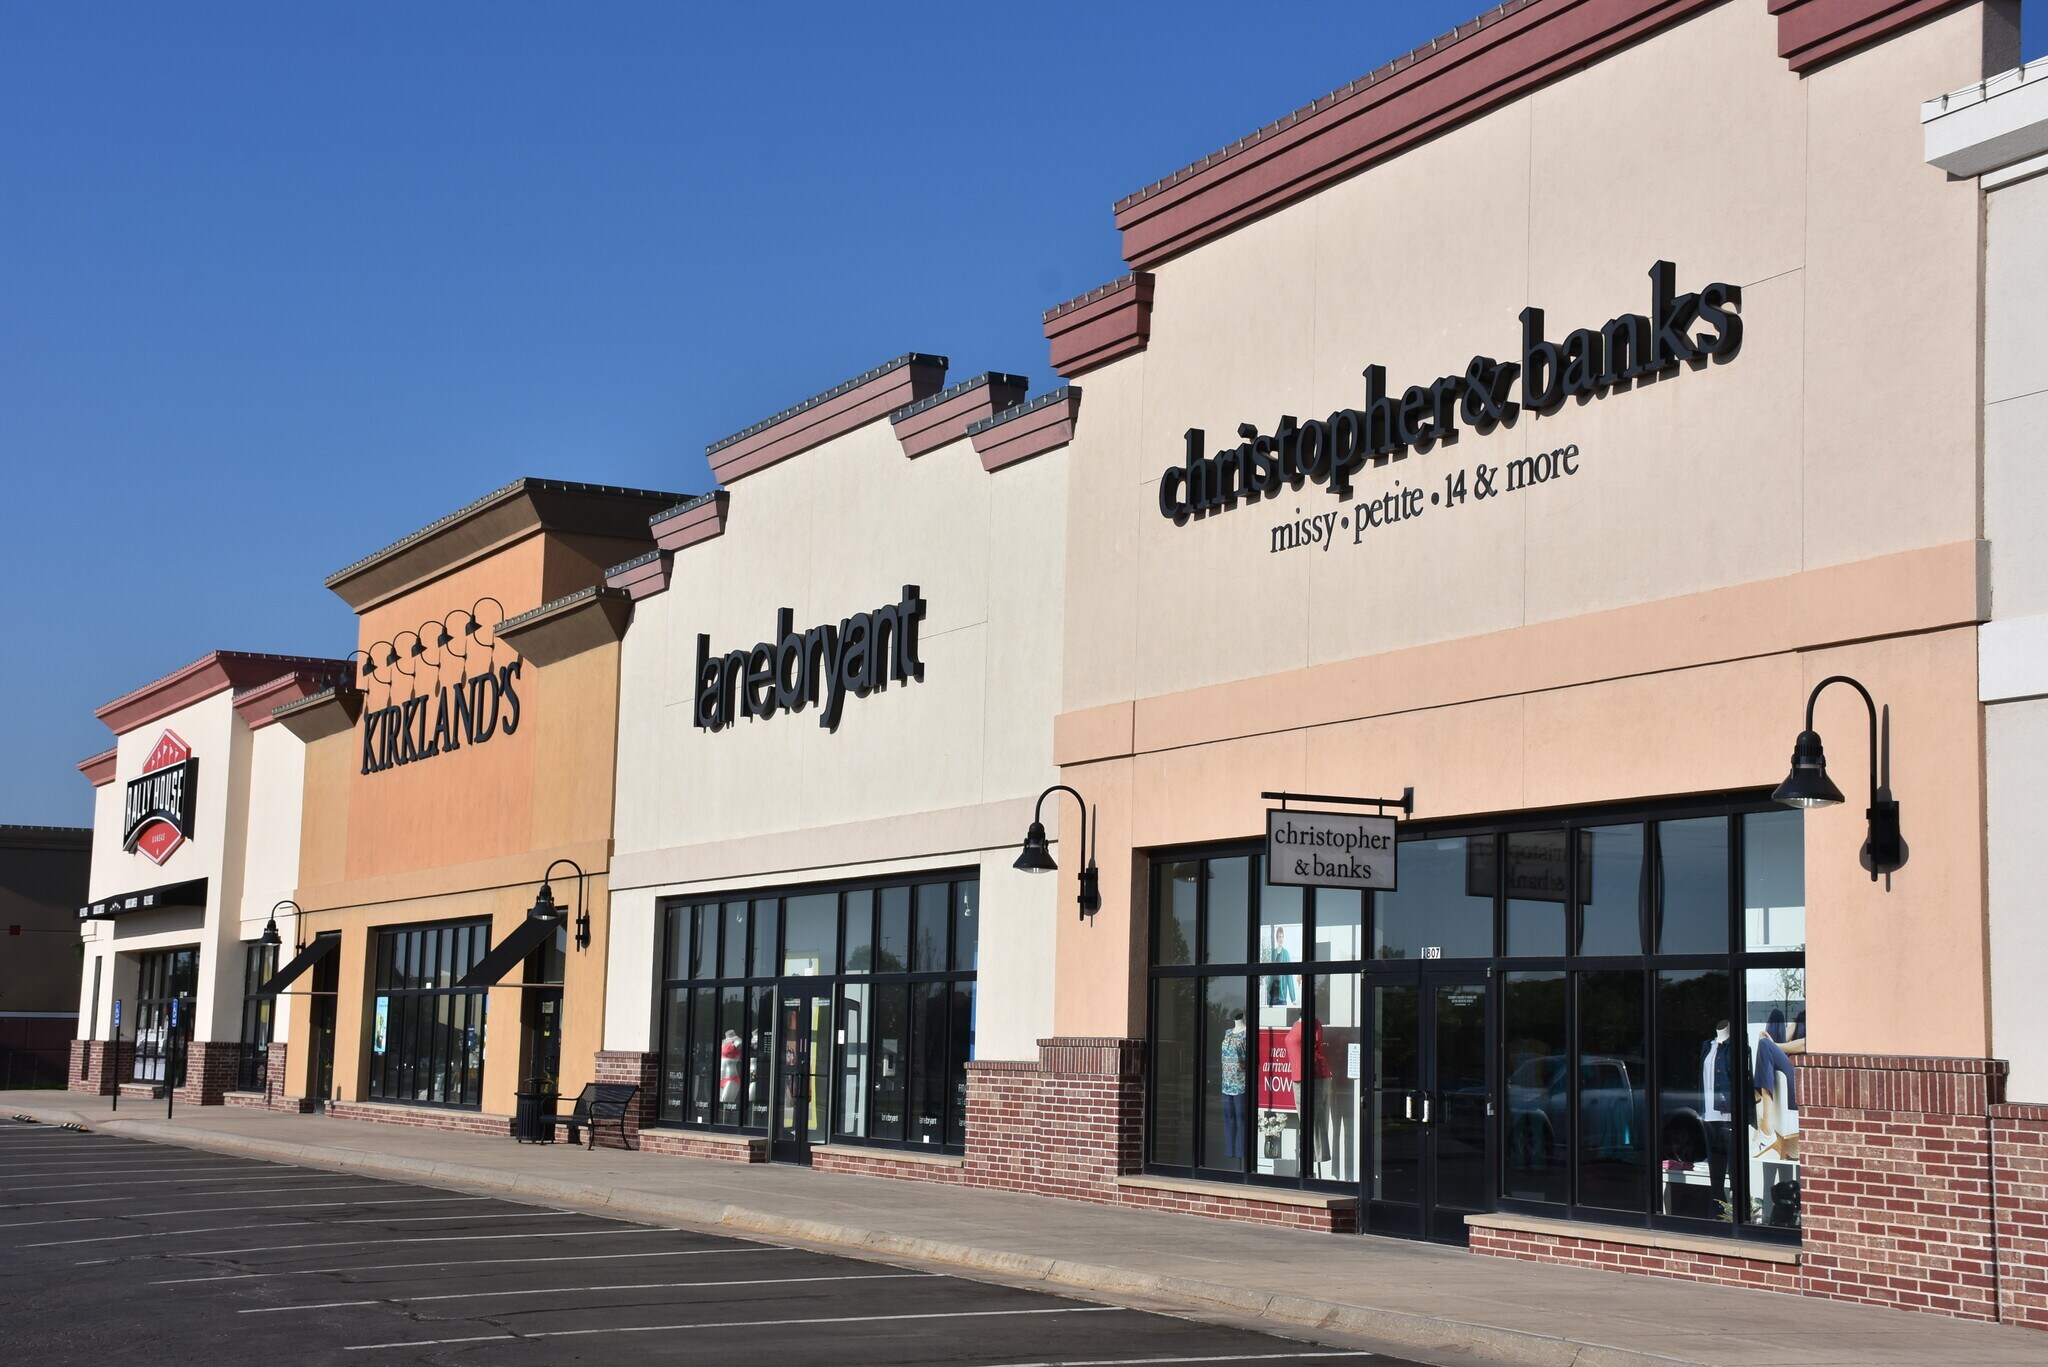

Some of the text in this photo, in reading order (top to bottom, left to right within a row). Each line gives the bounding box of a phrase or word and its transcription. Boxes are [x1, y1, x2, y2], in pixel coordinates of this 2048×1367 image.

[1270, 443, 1579, 552] missy petite 14 & more
[361, 661, 520, 775] KIRKLAND'S
[125, 768, 184, 836] RALLY HOUSE
[1275, 821, 1391, 853] christopher
[1422, 947, 1440, 959] 1807
[1270, 1047, 1287, 1058] new
[1264, 1076, 1293, 1092] NOW
